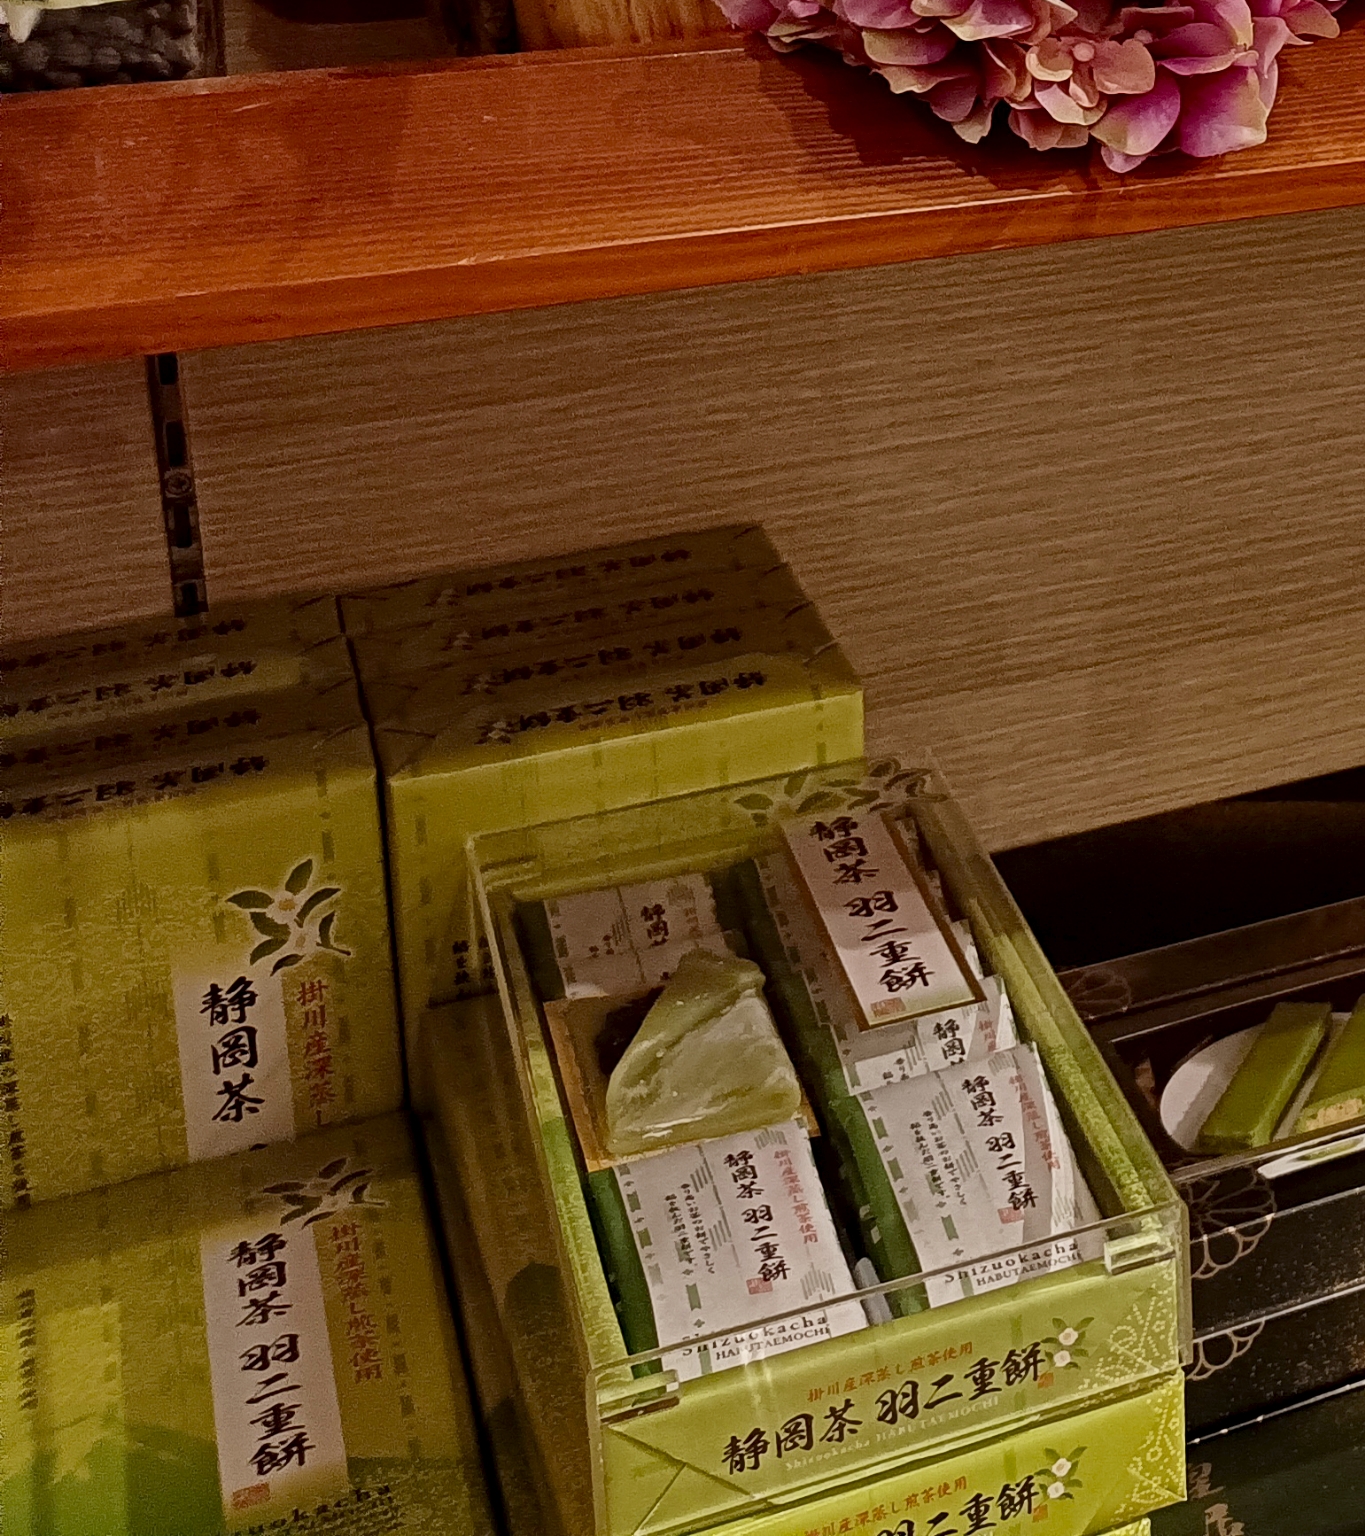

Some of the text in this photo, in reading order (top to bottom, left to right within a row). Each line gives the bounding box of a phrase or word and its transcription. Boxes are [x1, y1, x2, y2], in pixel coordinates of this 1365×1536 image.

[809, 816, 936, 993] 静岡茶 羽二重餅
[199, 976, 265, 1122] 静岡茶
[962, 1075, 1039, 1210] 静岡茶 羽二重餅
[723, 1150, 791, 1282] 静岡茶 羽二重餅
[228, 1233, 316, 1476] 静岡茶 羽二重餅
[721, 1341, 1046, 1476] 静岡茶 羽二重餅
